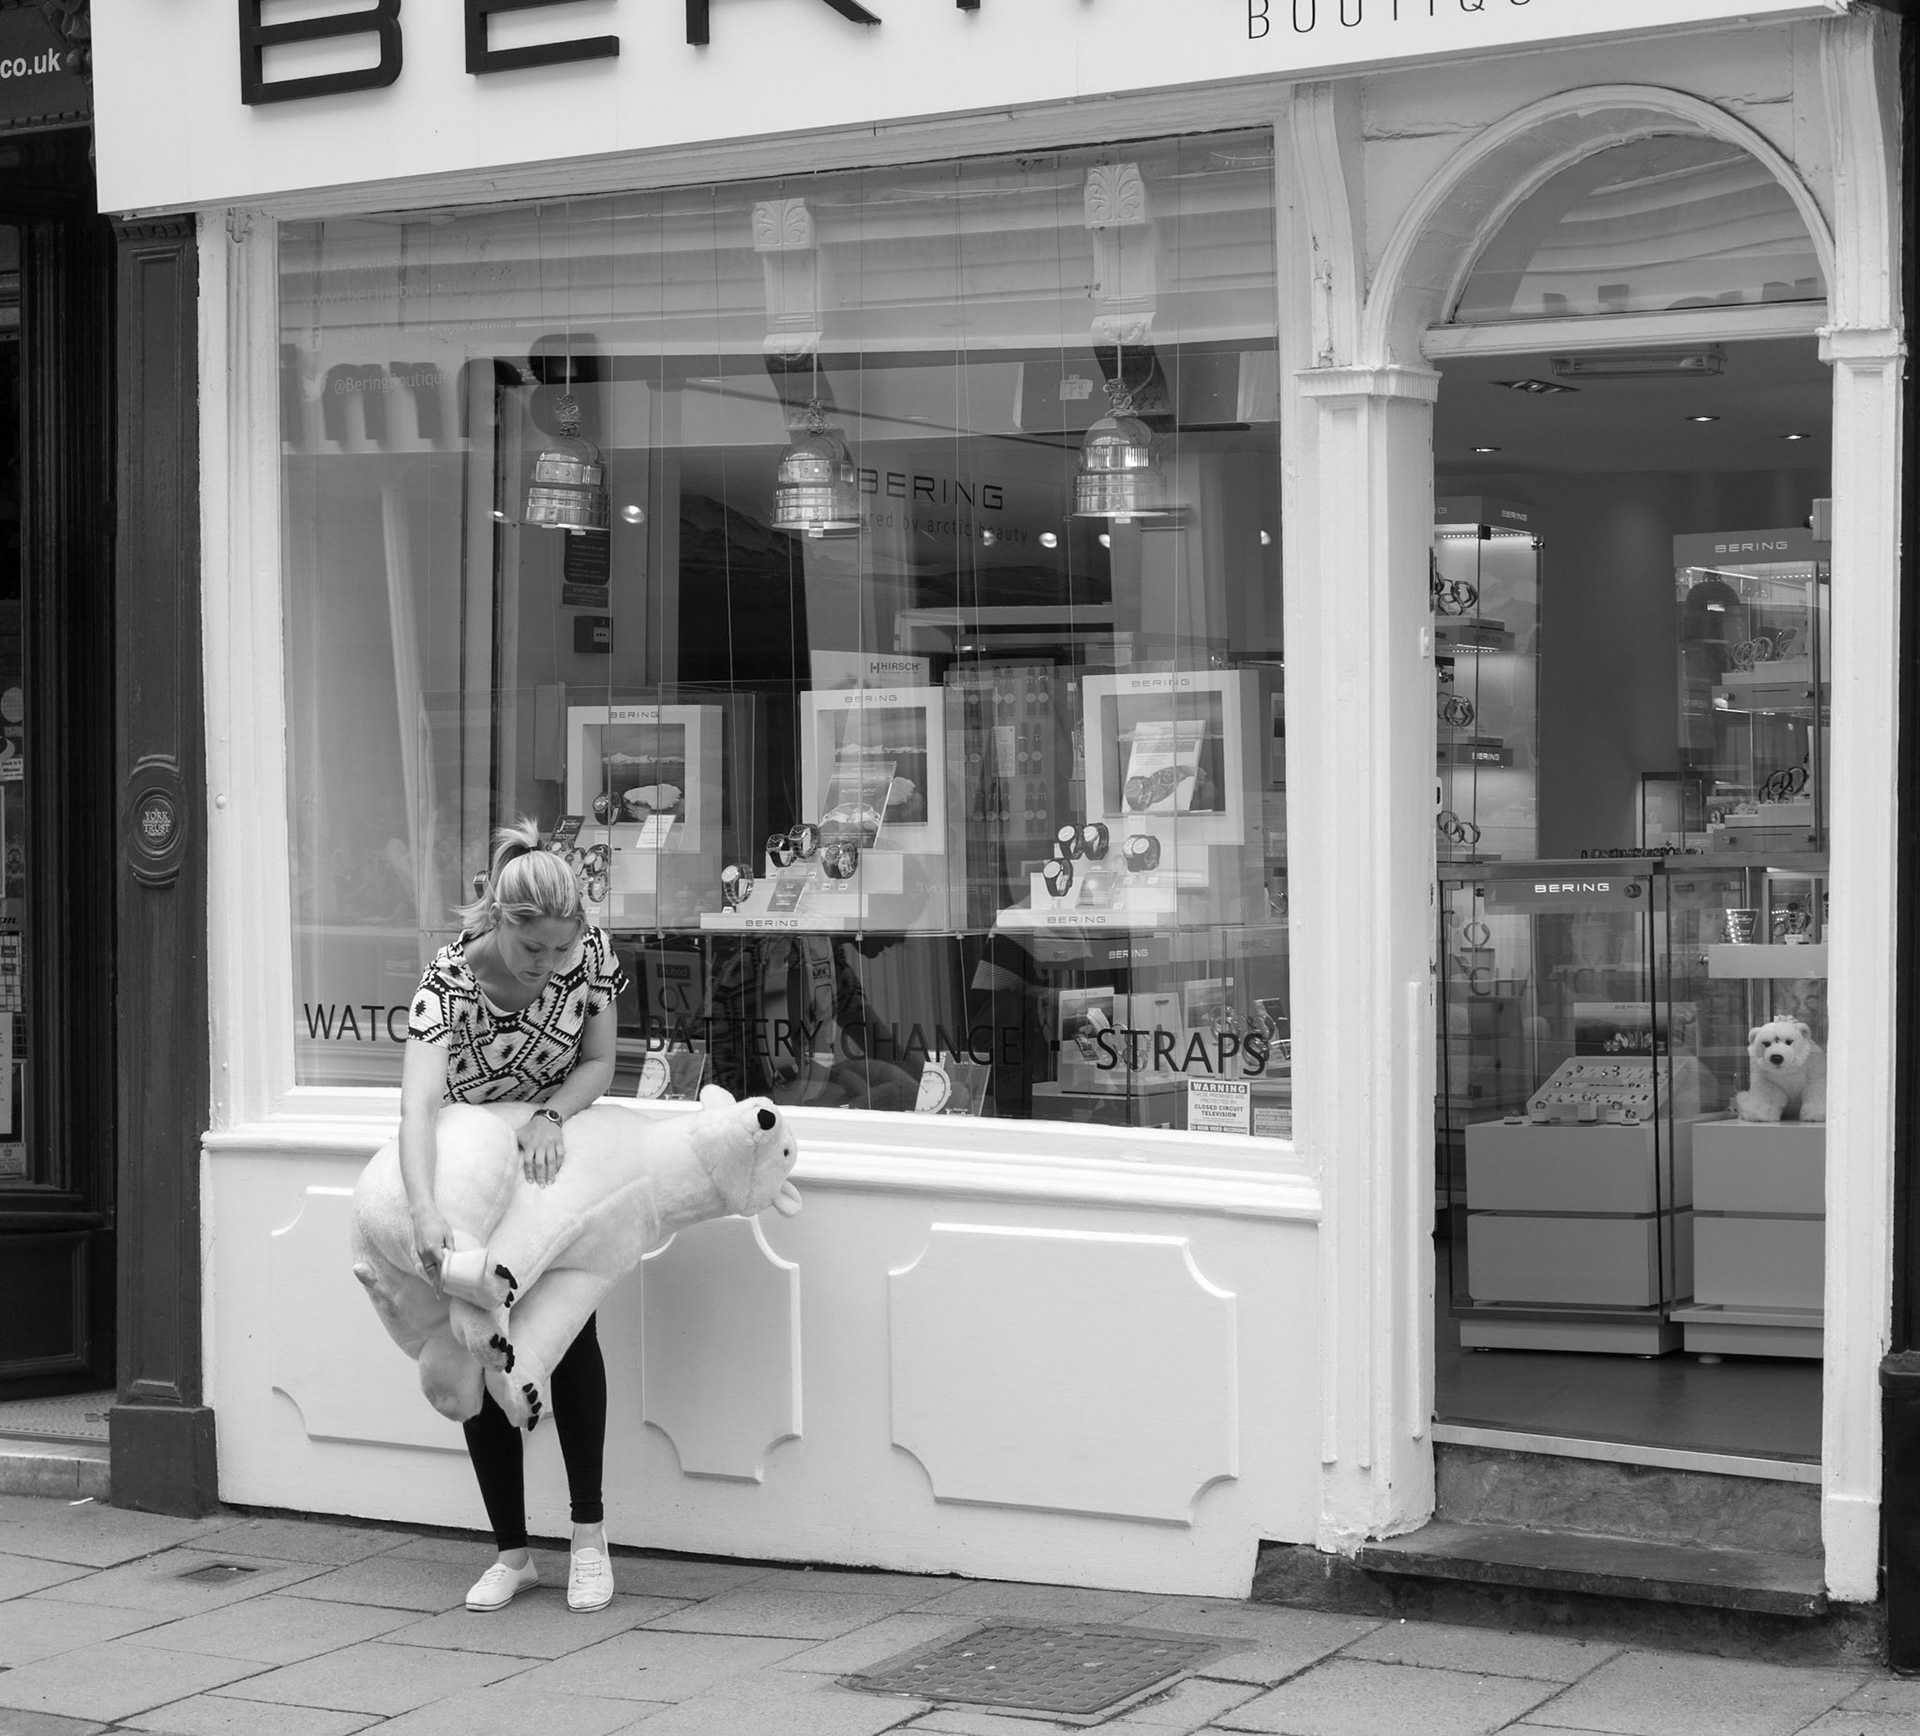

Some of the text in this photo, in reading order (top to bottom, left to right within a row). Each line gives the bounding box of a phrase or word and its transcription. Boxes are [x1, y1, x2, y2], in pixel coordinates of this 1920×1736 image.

[0, 47, 62, 79] co.uk
[856, 467, 1003, 510] BERING
[1714, 541, 1788, 554] BERING
[880, 661, 919, 672] HIRSCH
[1131, 678, 1191, 688] BERING
[844, 694, 898, 703] BERING
[611, 711, 659, 719] BERING
[144, 811, 169, 820] YORK
[143, 823, 171, 833] TRUST
[1534, 882, 1610, 893] BERING
[744, 918, 800, 927] BERING
[1046, 915, 1107, 924] BERING
[1108, 948, 1149, 960] BERING
[303, 1003, 1266, 1076] WATC BATTERY CHANGE STRAPS
[1193, 1082, 1246, 1094] WARNING
[1193, 1103, 1218, 1111] CLOSED
[1201, 1110, 1237, 1118] TELEVISION
